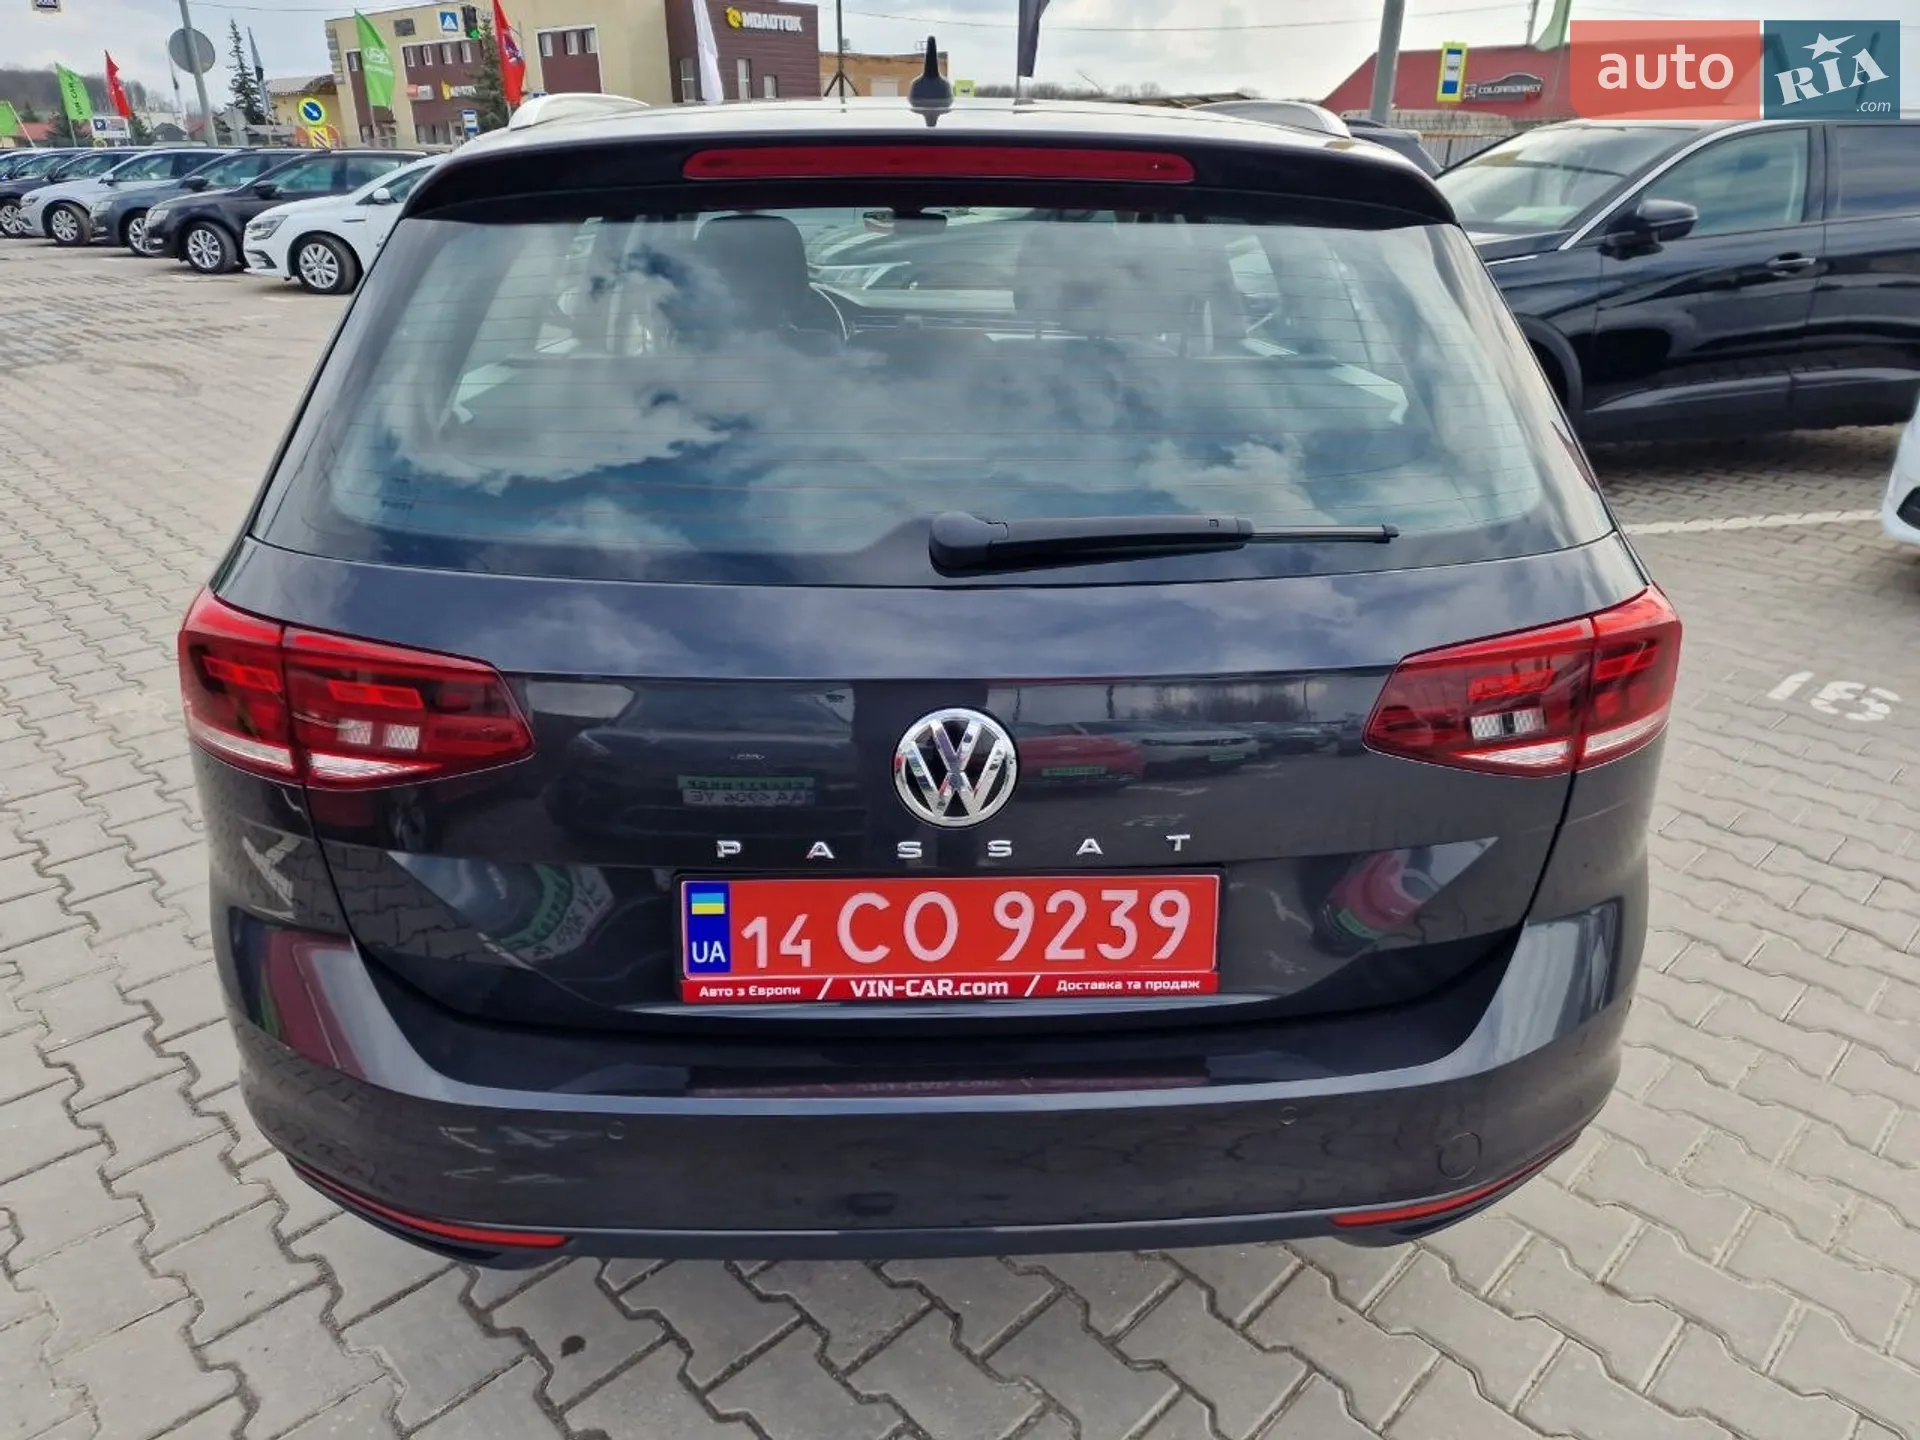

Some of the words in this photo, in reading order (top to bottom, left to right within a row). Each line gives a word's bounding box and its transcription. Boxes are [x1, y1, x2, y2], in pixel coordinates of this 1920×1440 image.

[716, 834, 1191, 859] PASSAT
[741, 913, 812, 969] 14
[993, 889, 1191, 962] 9239
[691, 941, 727, 964] UA
[699, 985, 734, 998] Авто
[737, 987, 746, 997] з
[749, 985, 802, 998] Європи
[850, 979, 1009, 998] VIN-CAR.com
[1056, 979, 1123, 992] Доставка
[1126, 981, 1141, 991] та
[1145, 980, 1200, 992] продаж
